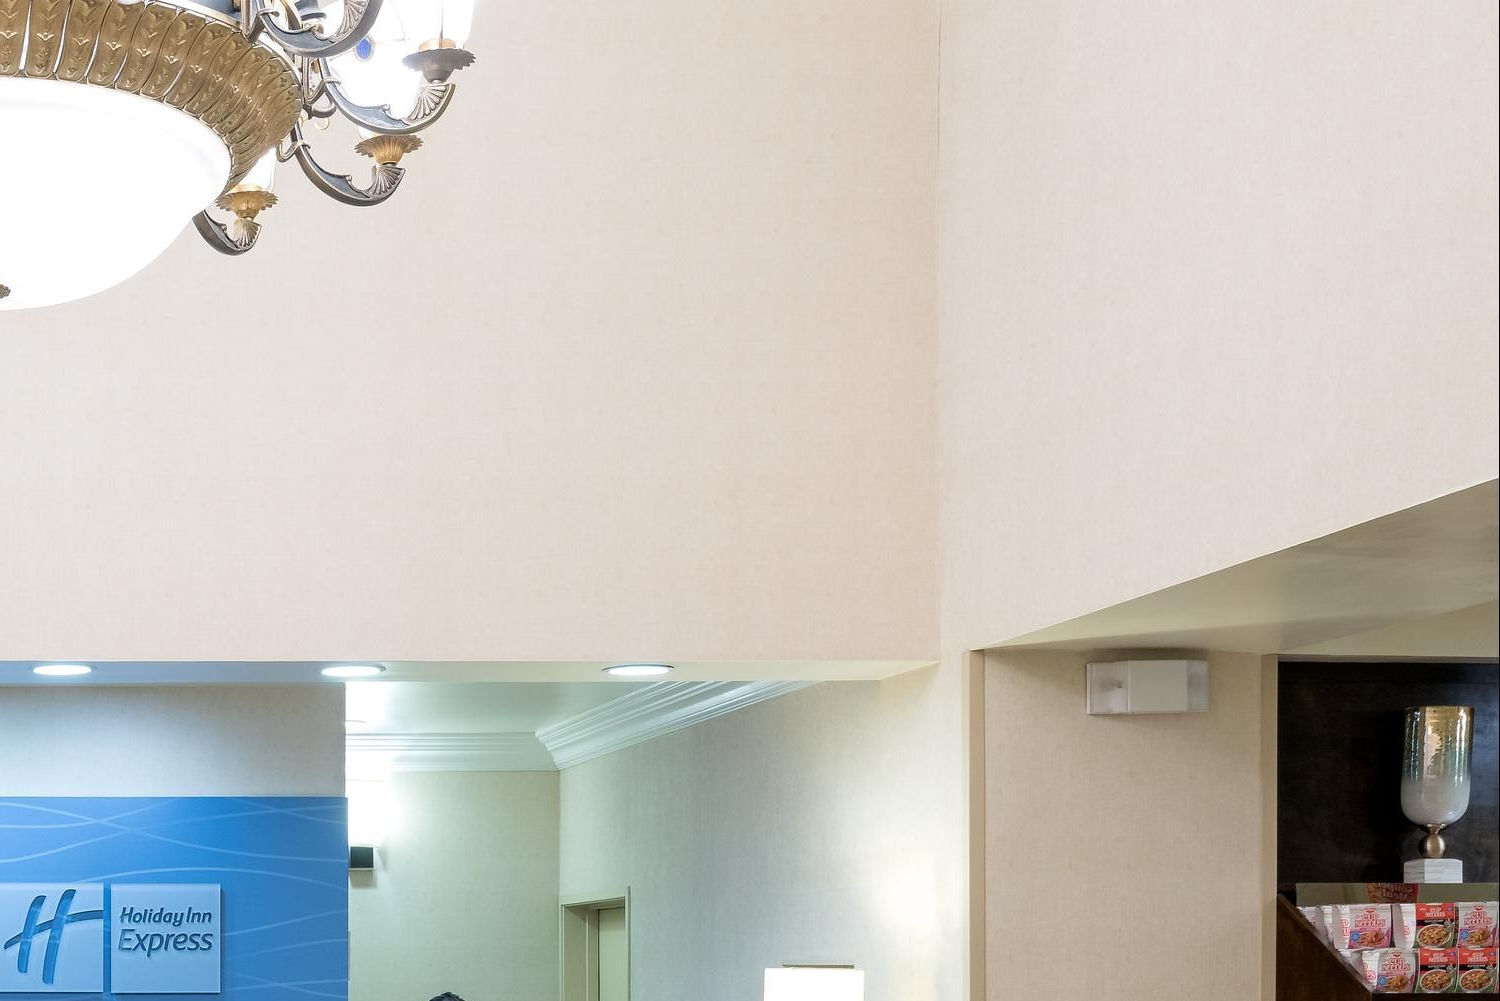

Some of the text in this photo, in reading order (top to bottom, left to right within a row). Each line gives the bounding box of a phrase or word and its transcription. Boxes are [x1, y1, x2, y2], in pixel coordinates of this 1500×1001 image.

[120, 907, 212, 926] Holiday Inn
[118, 929, 213, 957] Express
